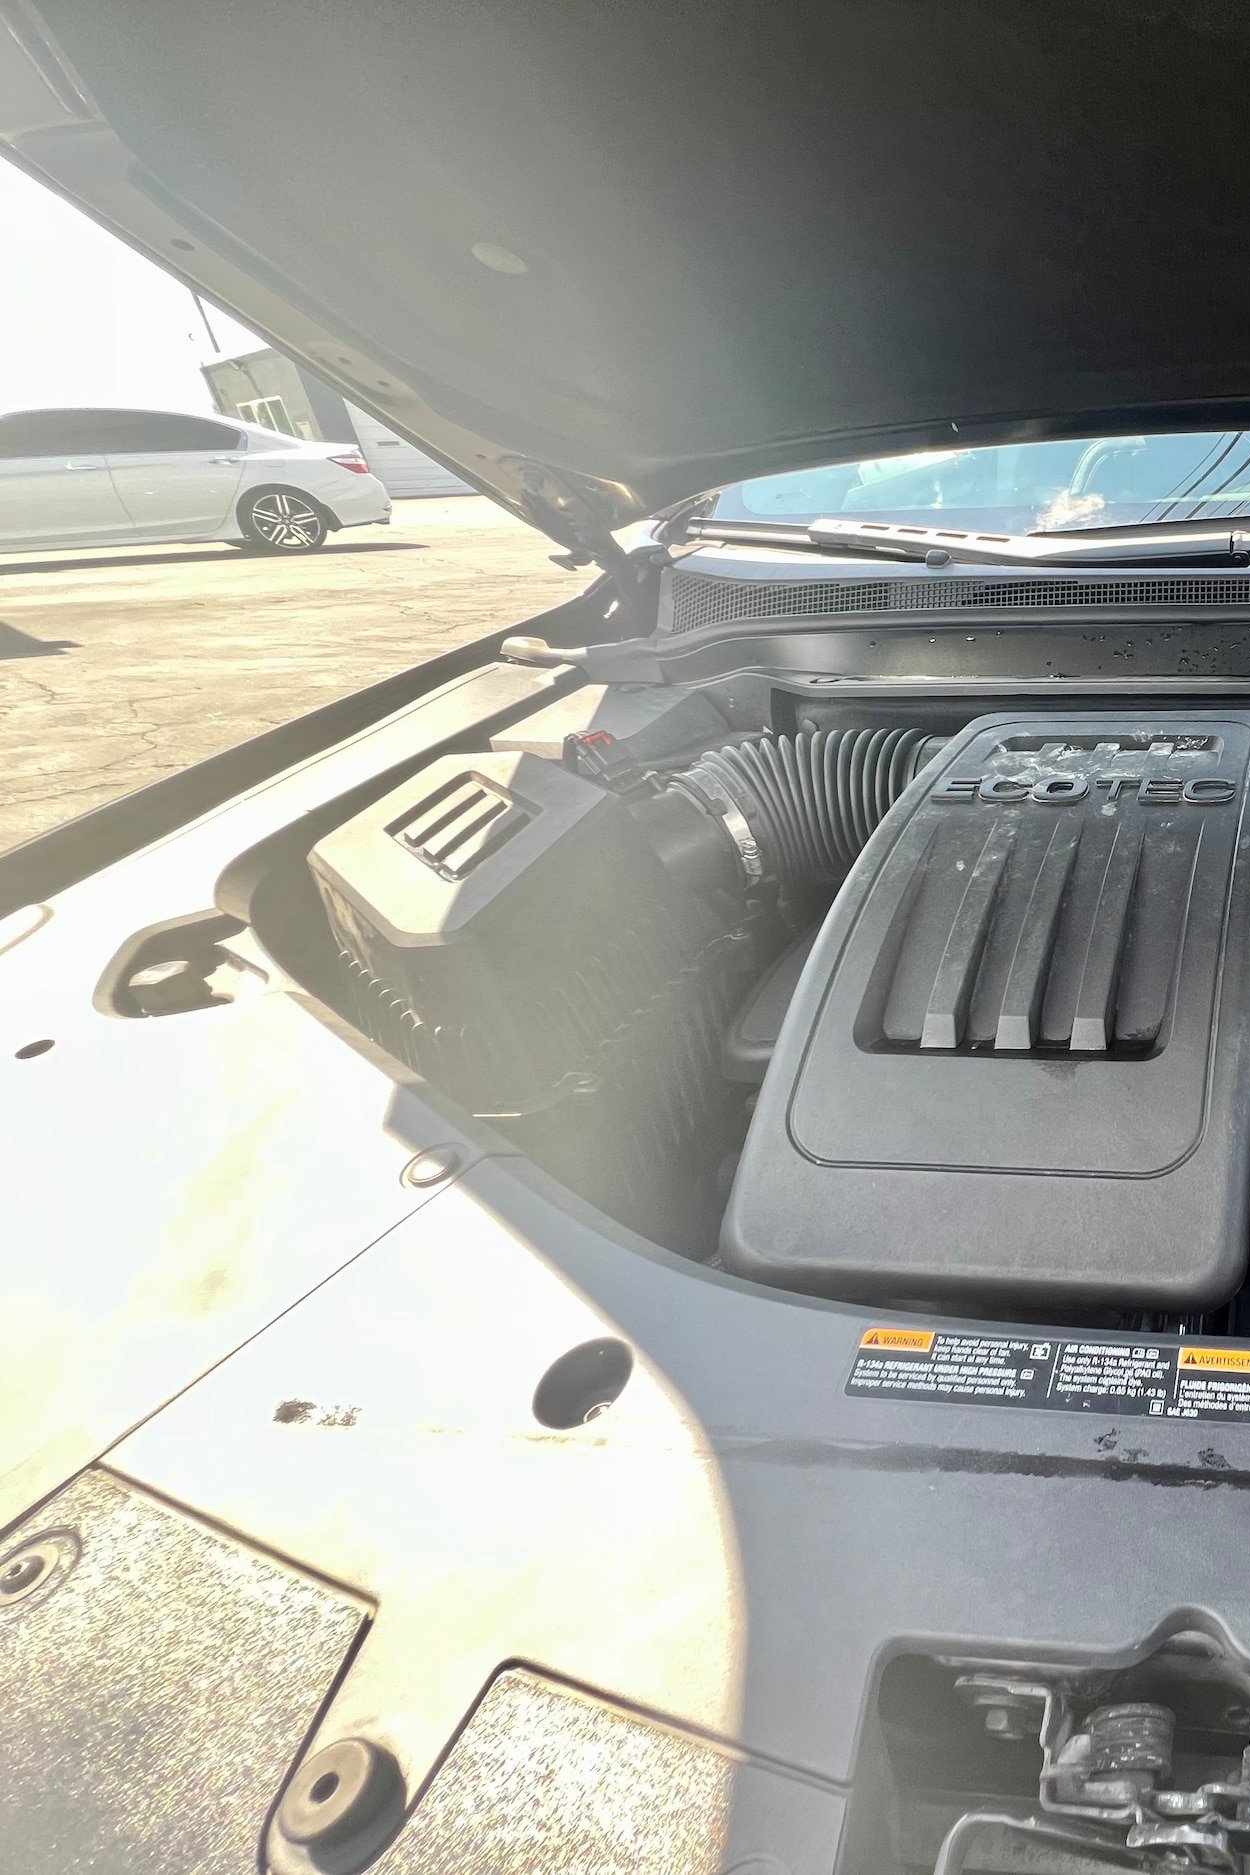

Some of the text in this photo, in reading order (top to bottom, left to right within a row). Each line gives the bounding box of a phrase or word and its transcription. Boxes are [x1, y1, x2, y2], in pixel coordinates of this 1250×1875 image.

[930, 777, 1236, 805] ECOTEC
[883, 1336, 924, 1346] WARNING
[1064, 1344, 1130, 1356] AIR CONDITIONING
[857, 1359, 1017, 1378] R-134a REFRIGERANT UNDER HIGH PRESSURE
[1180, 1380, 1206, 1389] FLUIDE
